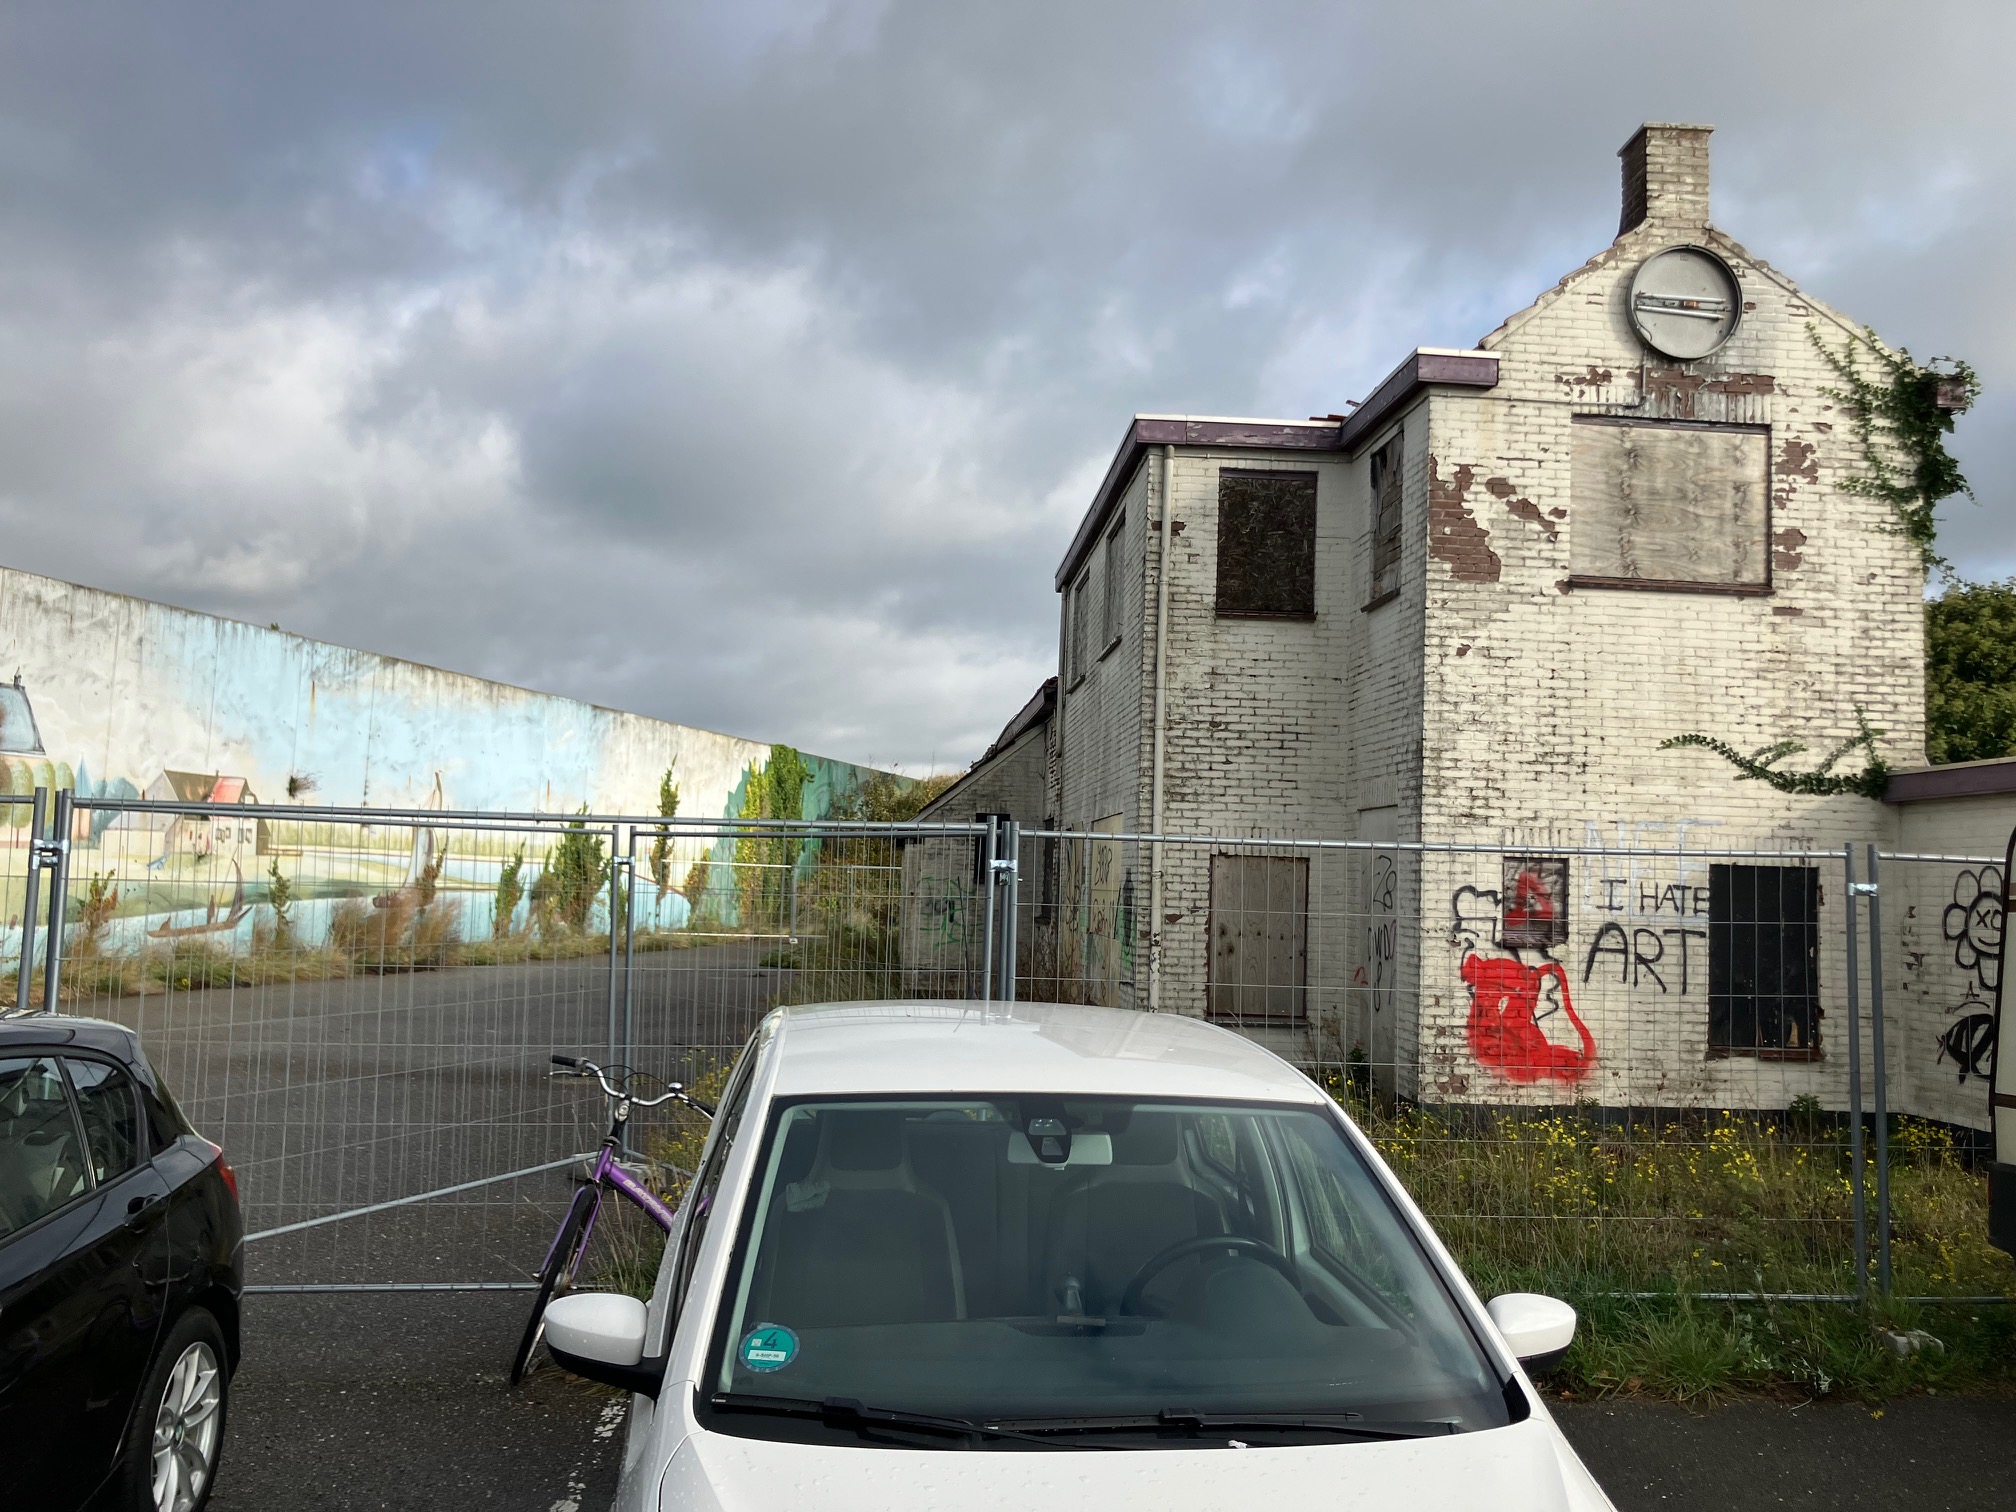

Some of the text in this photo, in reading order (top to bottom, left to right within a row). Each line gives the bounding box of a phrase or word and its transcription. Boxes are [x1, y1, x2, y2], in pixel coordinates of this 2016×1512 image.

[1596, 879, 1710, 917] I HATE
[1583, 922, 1706, 995] ART
[763, 1331, 777, 1349] 4
